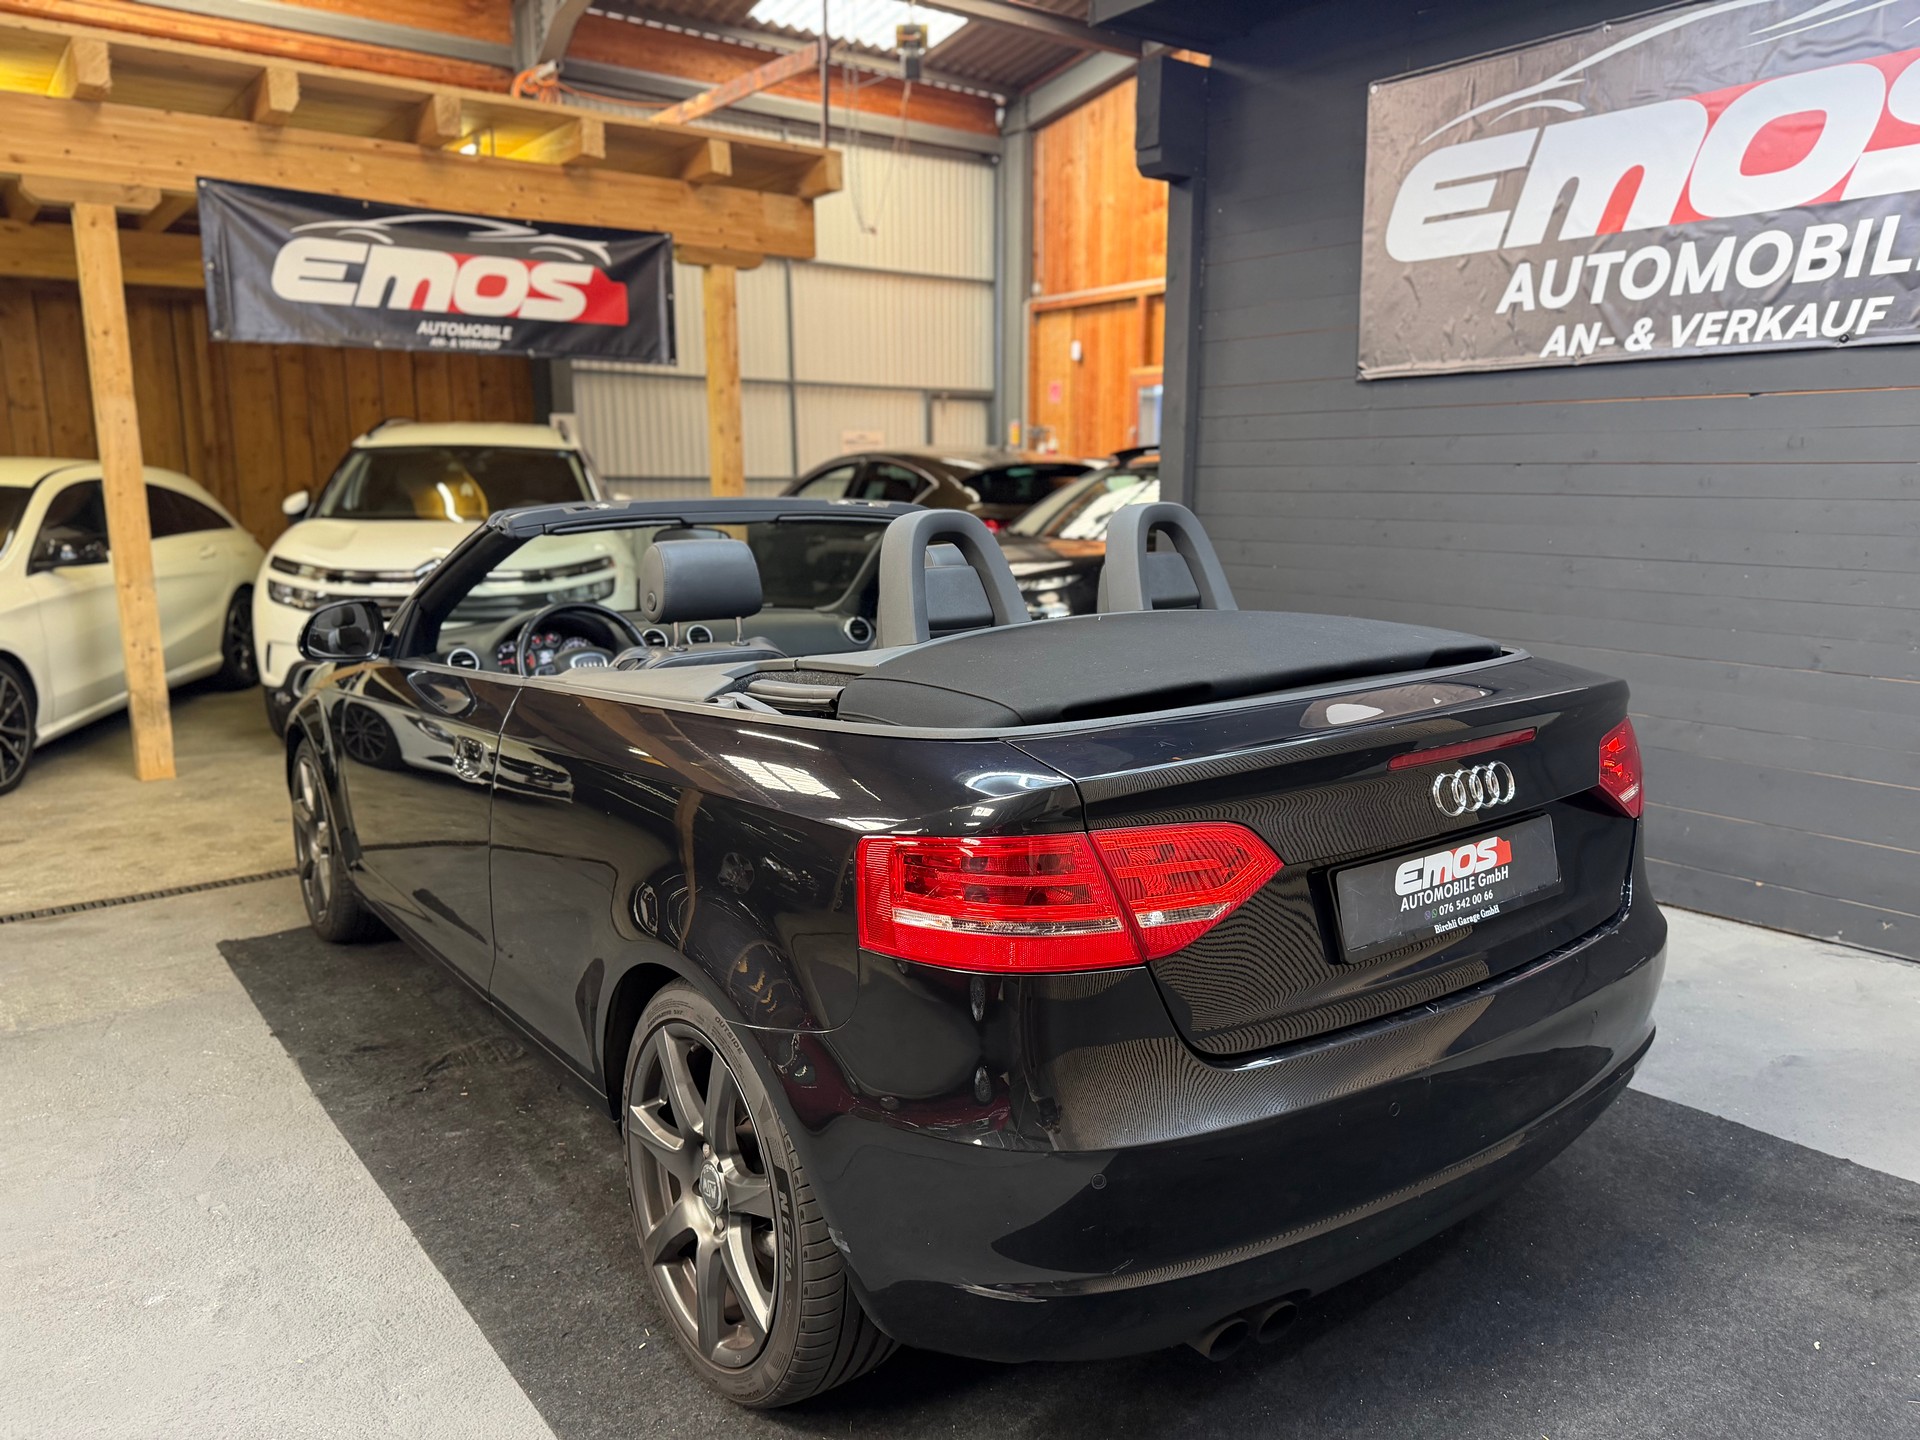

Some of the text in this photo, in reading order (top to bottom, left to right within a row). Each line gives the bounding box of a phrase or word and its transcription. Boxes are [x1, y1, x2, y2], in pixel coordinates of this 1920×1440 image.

[271, 237, 595, 322] EMOS
[1495, 215, 1920, 314] AUTOMOBIL
[416, 320, 513, 341] AUTOMOBILE
[1540, 296, 1895, 358] AN- & VERKAUF
[1395, 836, 1498, 896] EMOS
[1400, 865, 1509, 912] AUTOMOBILE GmbH
[1434, 904, 1500, 934] Birchli Garage GmbH
[1439, 889, 1494, 916] 076 542 00 66
[714, 1016, 744, 1054] OUTSIDE
